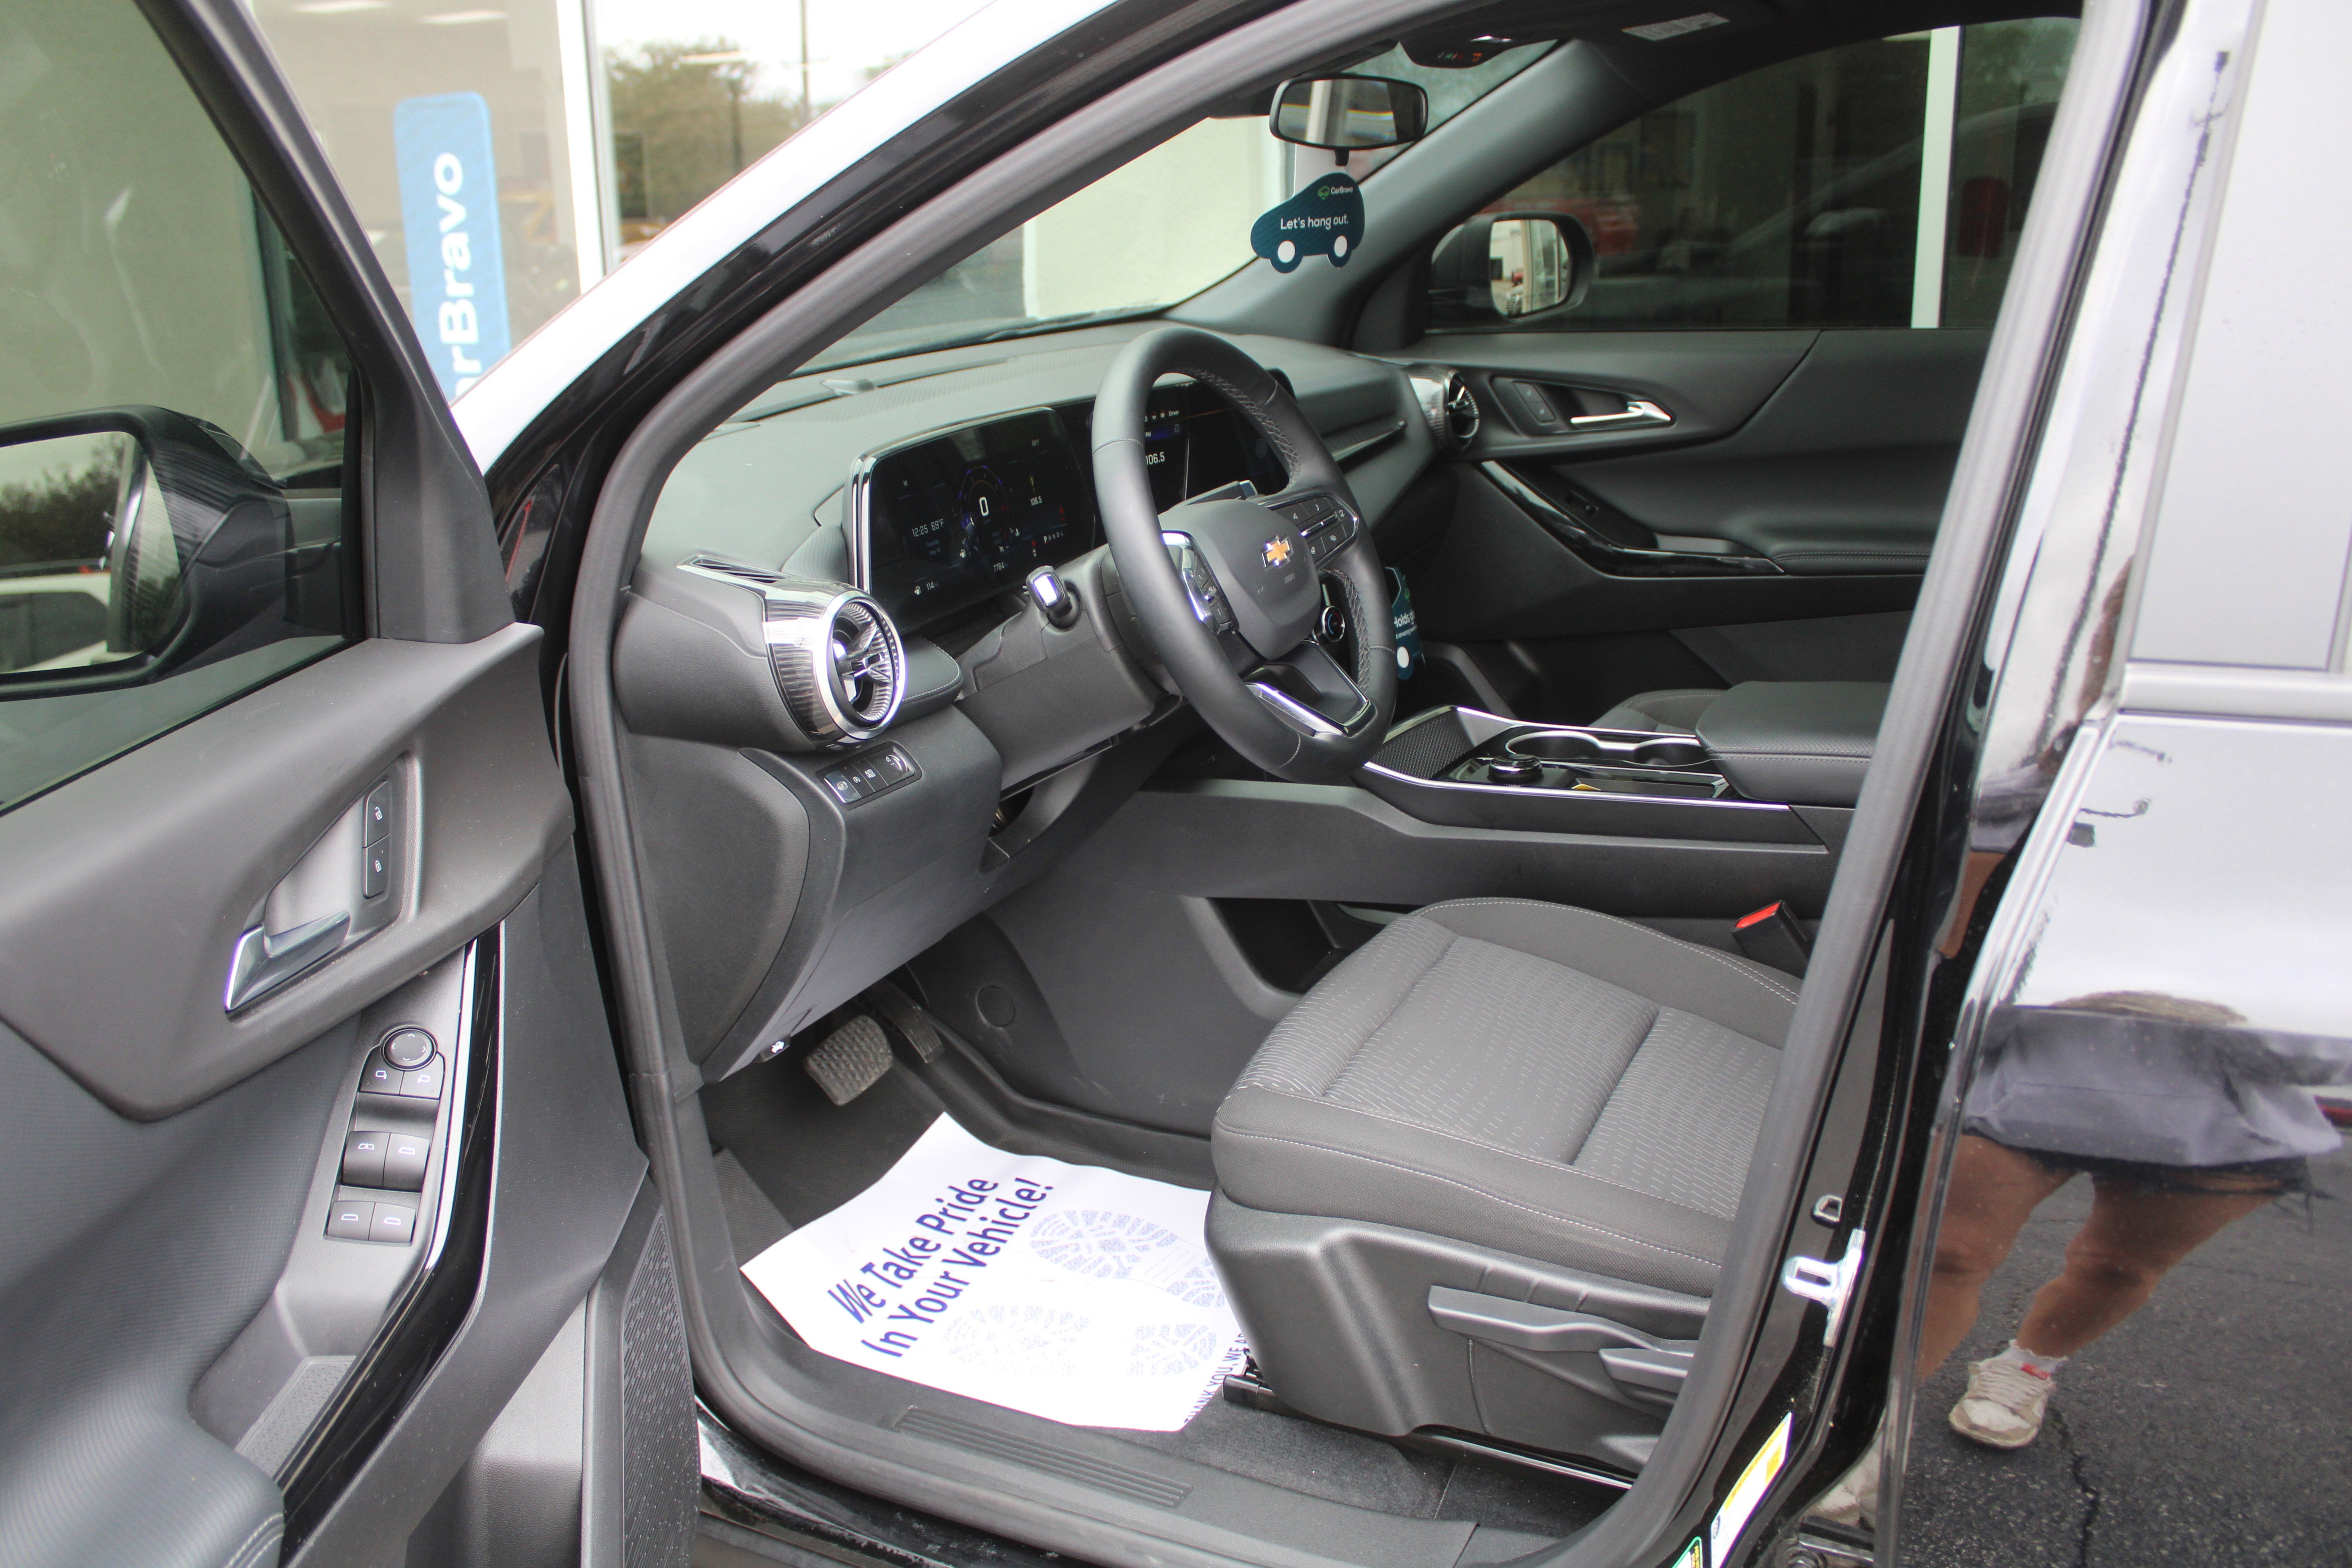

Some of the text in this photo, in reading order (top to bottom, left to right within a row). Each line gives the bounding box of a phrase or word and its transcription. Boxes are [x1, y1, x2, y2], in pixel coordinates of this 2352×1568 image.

[1331, 186, 1353, 194] CarBravo
[1281, 214, 1349, 230] Let's hang out.
[1145, 451, 1165, 465] 106.5
[979, 496, 989, 517] 0
[1030, 496, 1042, 506] 106.5
[911, 524, 928, 537] 12:25
[827, 1178, 999, 1323] We Take Pride
[860, 1177, 1054, 1358] In Your Vehicle!
